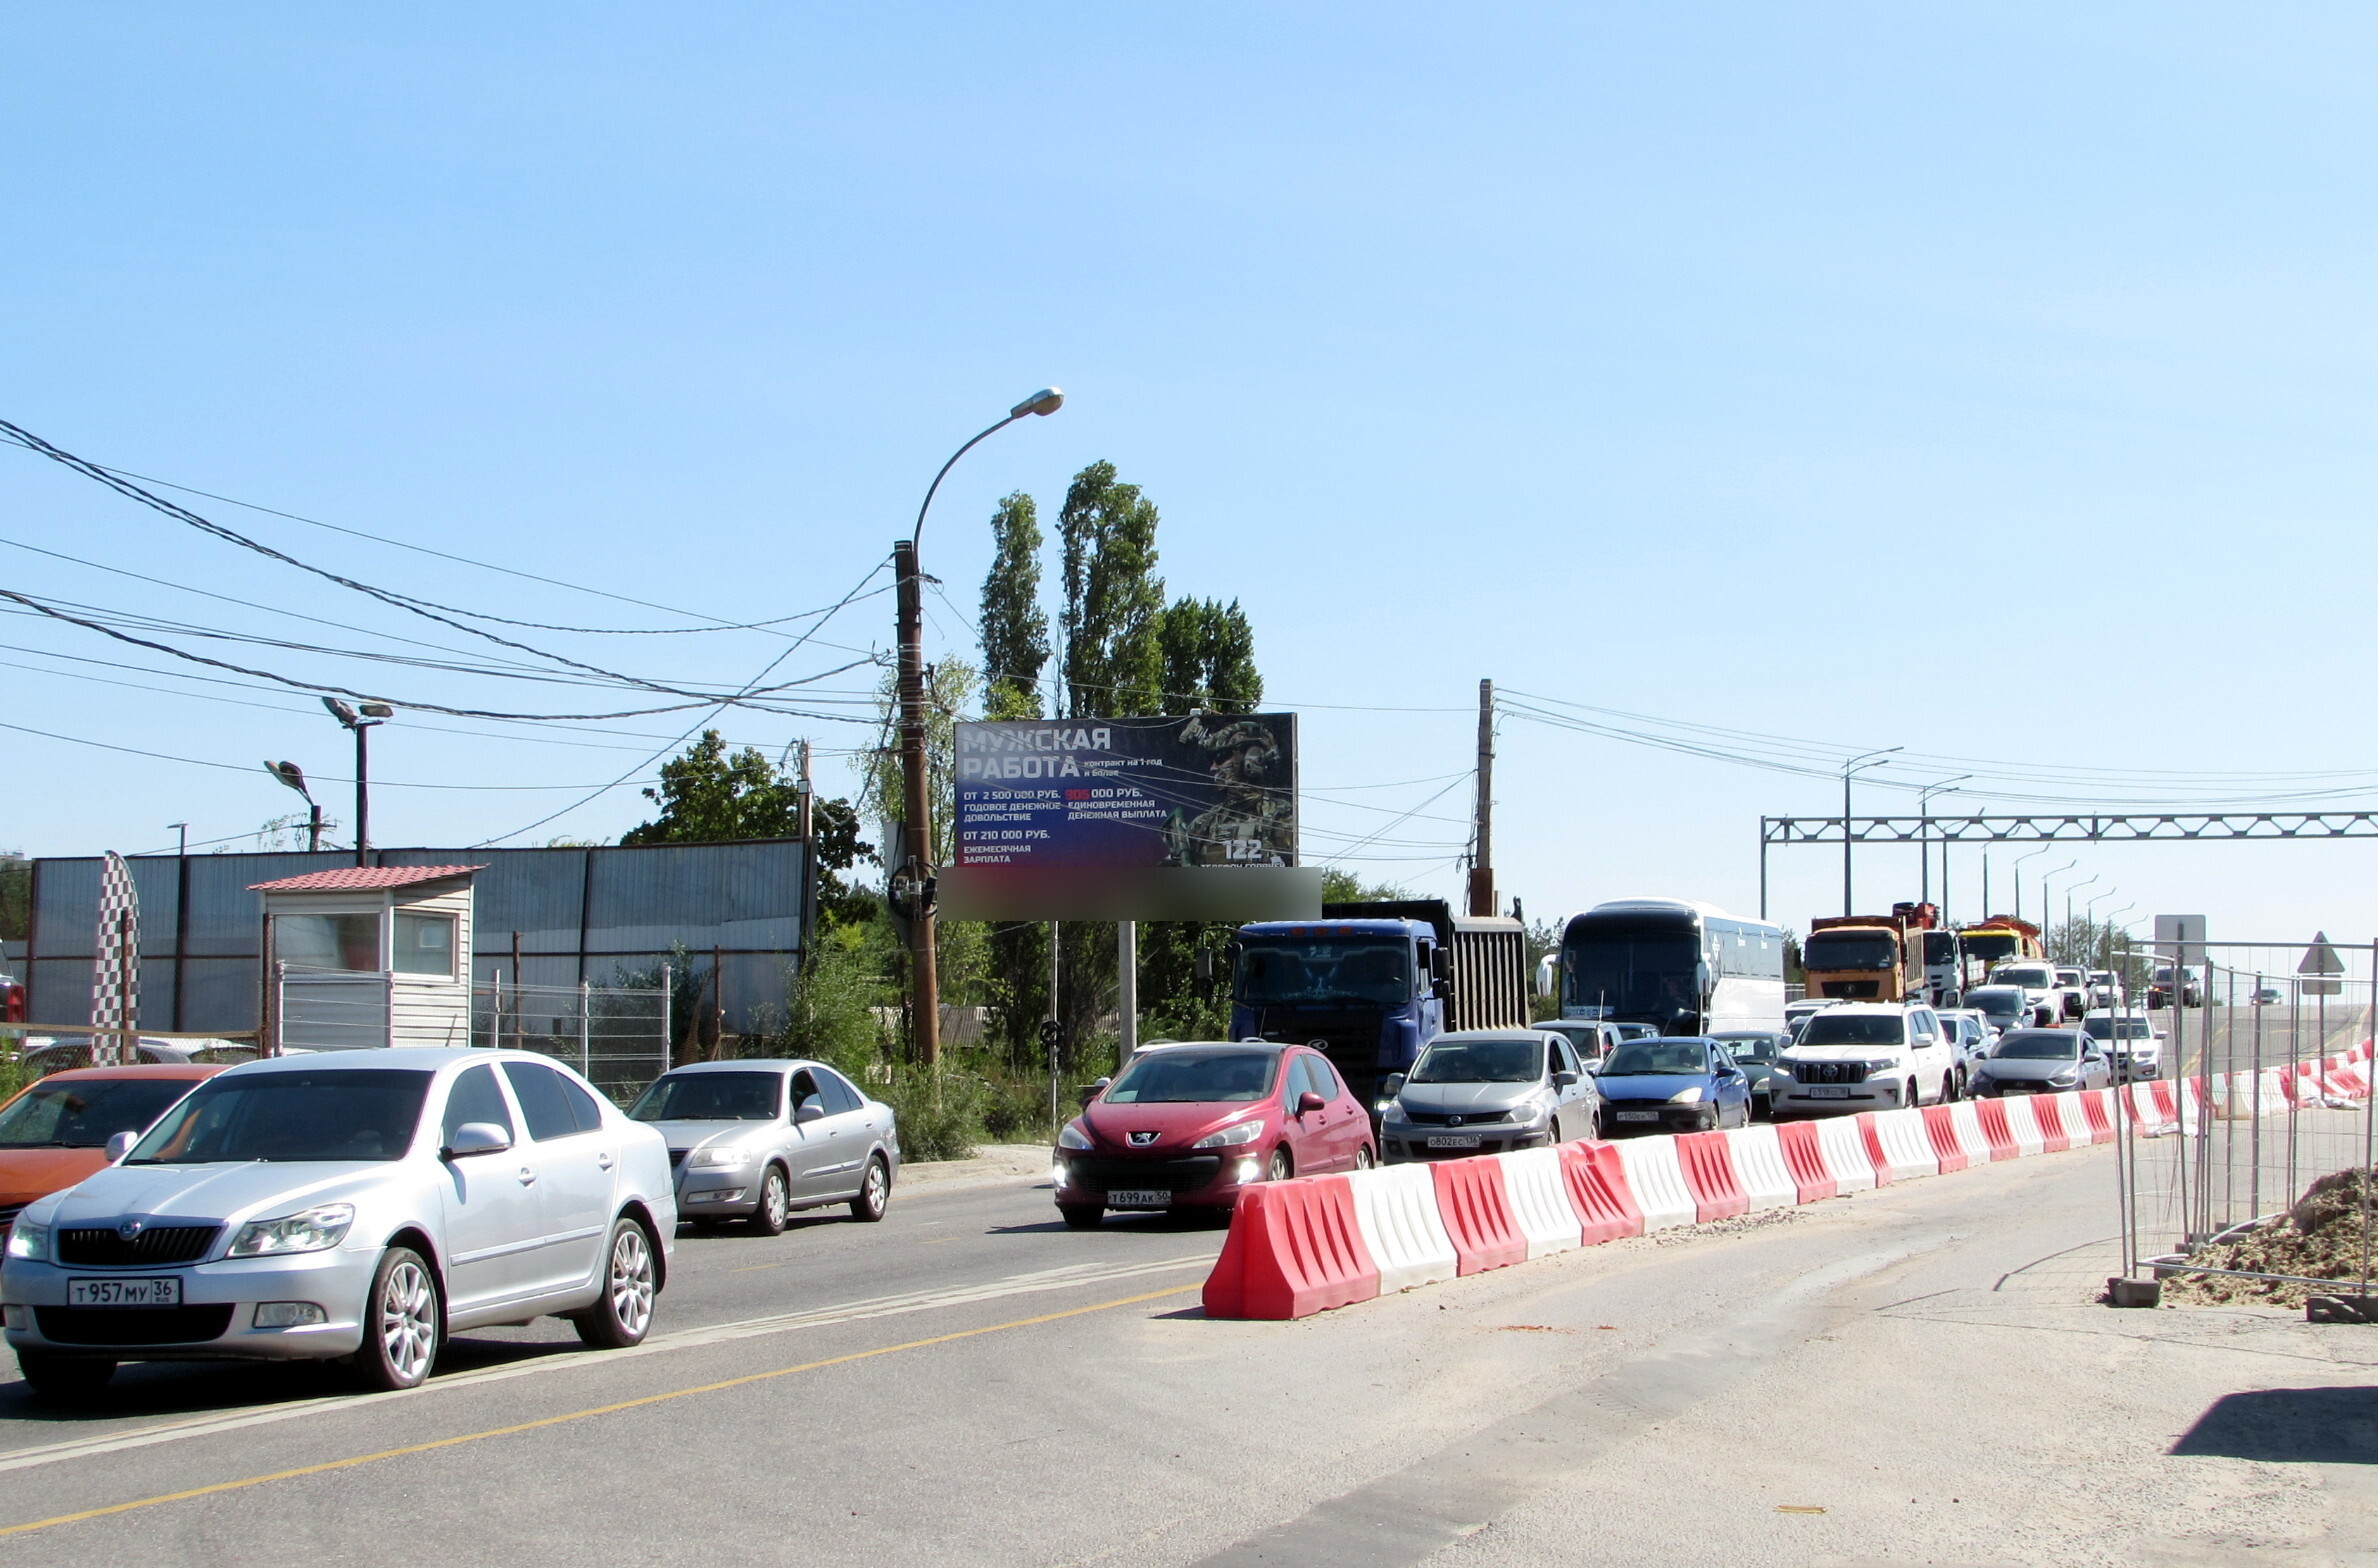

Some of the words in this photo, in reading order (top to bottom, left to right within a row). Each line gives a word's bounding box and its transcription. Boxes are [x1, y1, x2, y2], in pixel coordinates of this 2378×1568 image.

[963, 728, 1111, 753] МУЖСКАЯ
[963, 756, 1080, 779] РАБОТА
[1084, 759, 1125, 768] контракт
[1127, 759, 1138, 767] на
[1148, 759, 1163, 768] год
[1092, 769, 1119, 777] более
[964, 792, 978, 800] ОТ
[983, 792, 990, 800] 2
[992, 791, 1012, 800] 500
[1014, 791, 1035, 800] 000
[1037, 790, 1061, 799] РУБ.
[1091, 788, 1113, 798] 000
[1117, 788, 1143, 798] РУБ.
[964, 803, 1007, 812] ГОДОВОЕ
[1009, 802, 1061, 812] ДЕНЕЖНОЕ
[1068, 800, 1155, 810] ЕДИНОВРЕМЕННАЯ
[964, 813, 1031, 823] ДОВОЛЬСТВИЕ
[1068, 811, 1119, 821] ДЕНЕЖНАЯ
[1121, 809, 1167, 819] ВЫПЛАТА
[963, 831, 978, 841] ОТ
[980, 831, 998, 840] 210
[1001, 830, 1022, 840] 000
[1025, 829, 1050, 839] РУБ.
[964, 845, 1031, 854] ЕЖЕМЕСЯЧНАЯ
[1225, 839, 1262, 860] 122
[963, 855, 1011, 864] ЗАРПЛАТА
[154, 1281, 172, 1296] 36
